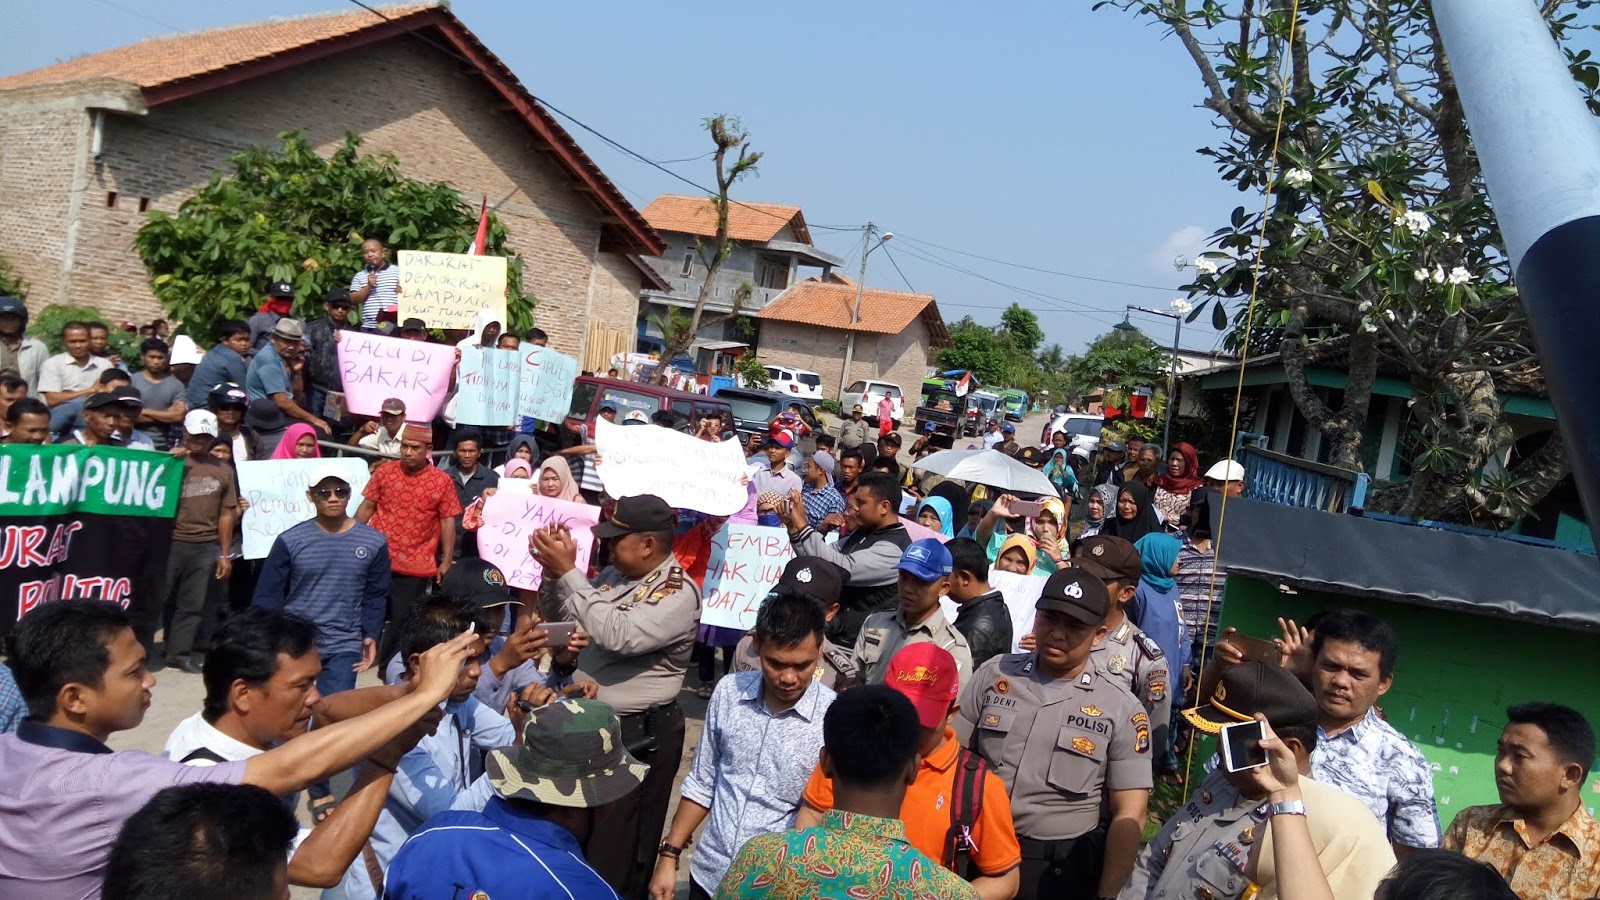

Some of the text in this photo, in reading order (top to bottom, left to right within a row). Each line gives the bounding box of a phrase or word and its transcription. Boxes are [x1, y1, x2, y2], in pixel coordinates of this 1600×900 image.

[402, 288, 490, 309] LAMPUNG
[344, 338, 431, 366] LALU DI
[343, 360, 432, 396] BAKAR
[0, 453, 166, 511] LAMPUNG
[702, 587, 745, 611] DAT
[1067, 714, 1109, 735] POLISI
